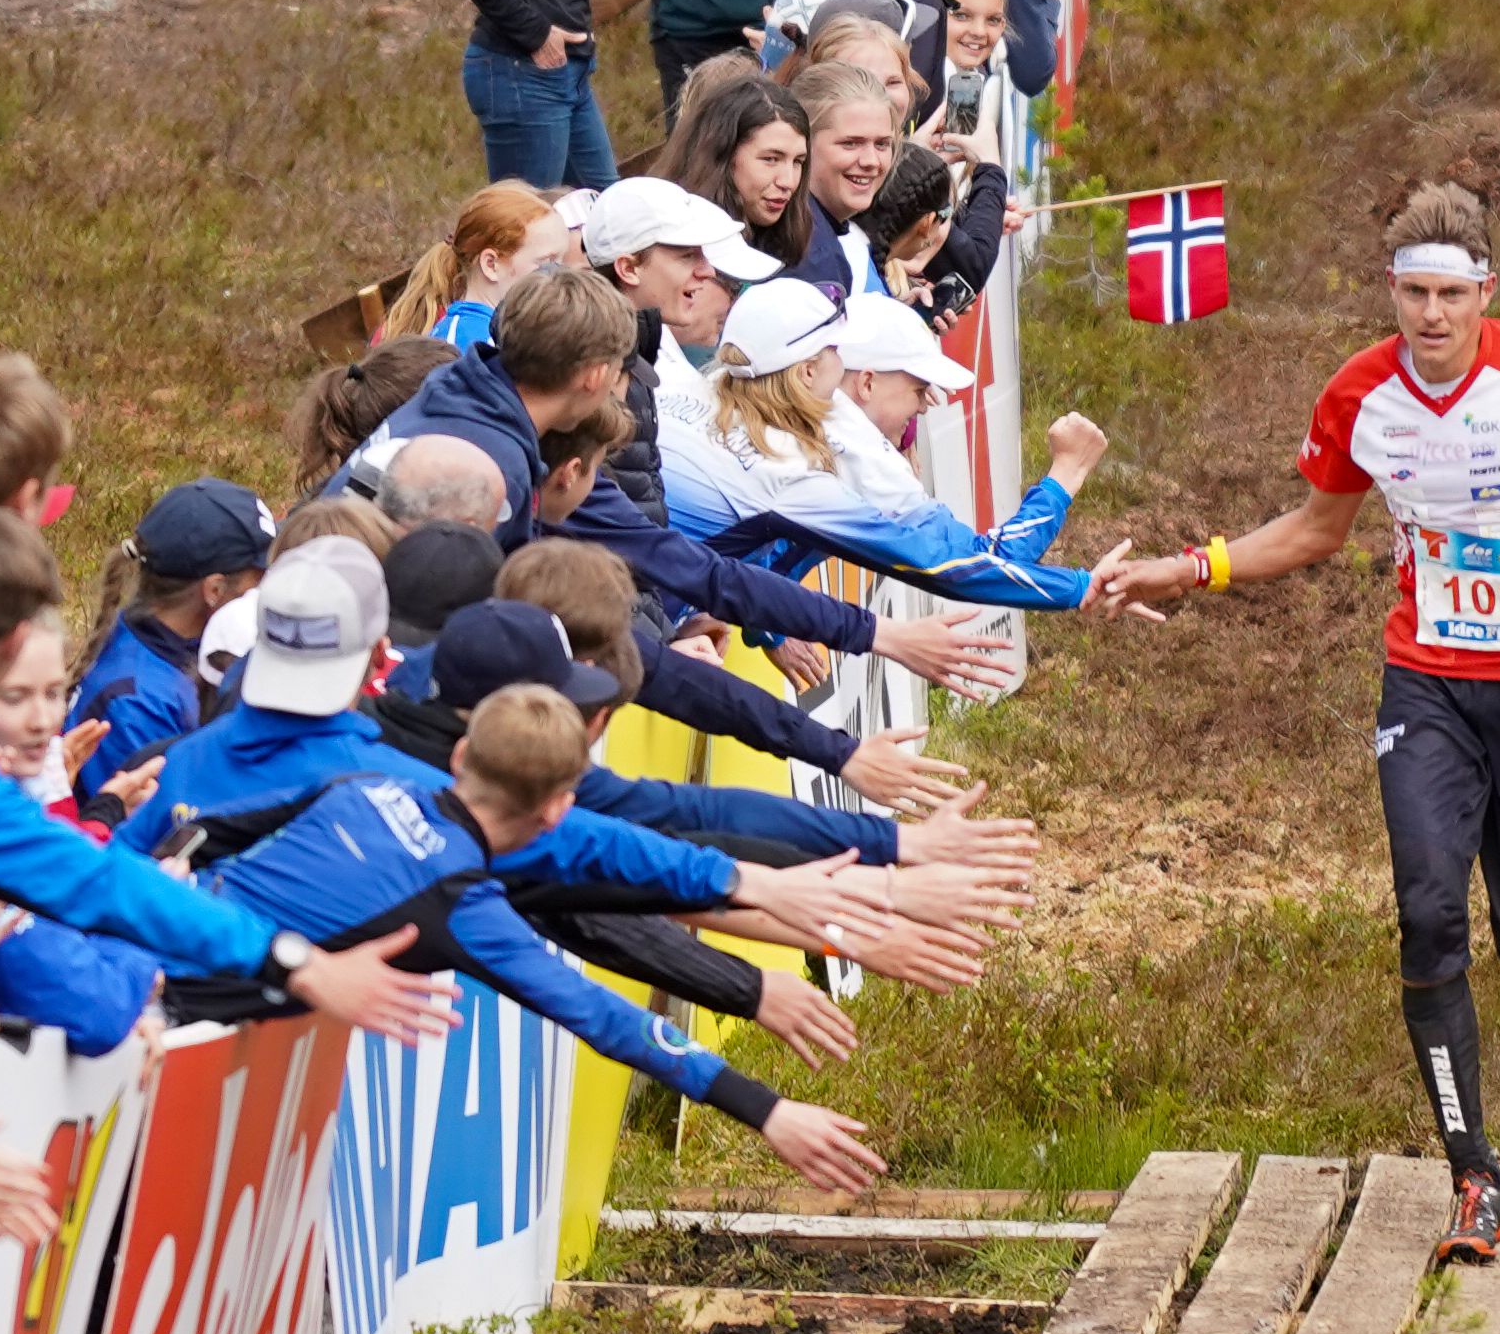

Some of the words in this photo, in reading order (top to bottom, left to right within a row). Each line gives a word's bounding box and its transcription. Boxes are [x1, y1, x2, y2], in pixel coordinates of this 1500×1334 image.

[1471, 421, 1500, 434] EGK
[1447, 621, 1486, 640] Idre
[1429, 1045, 1467, 1133] TRIMTEX
